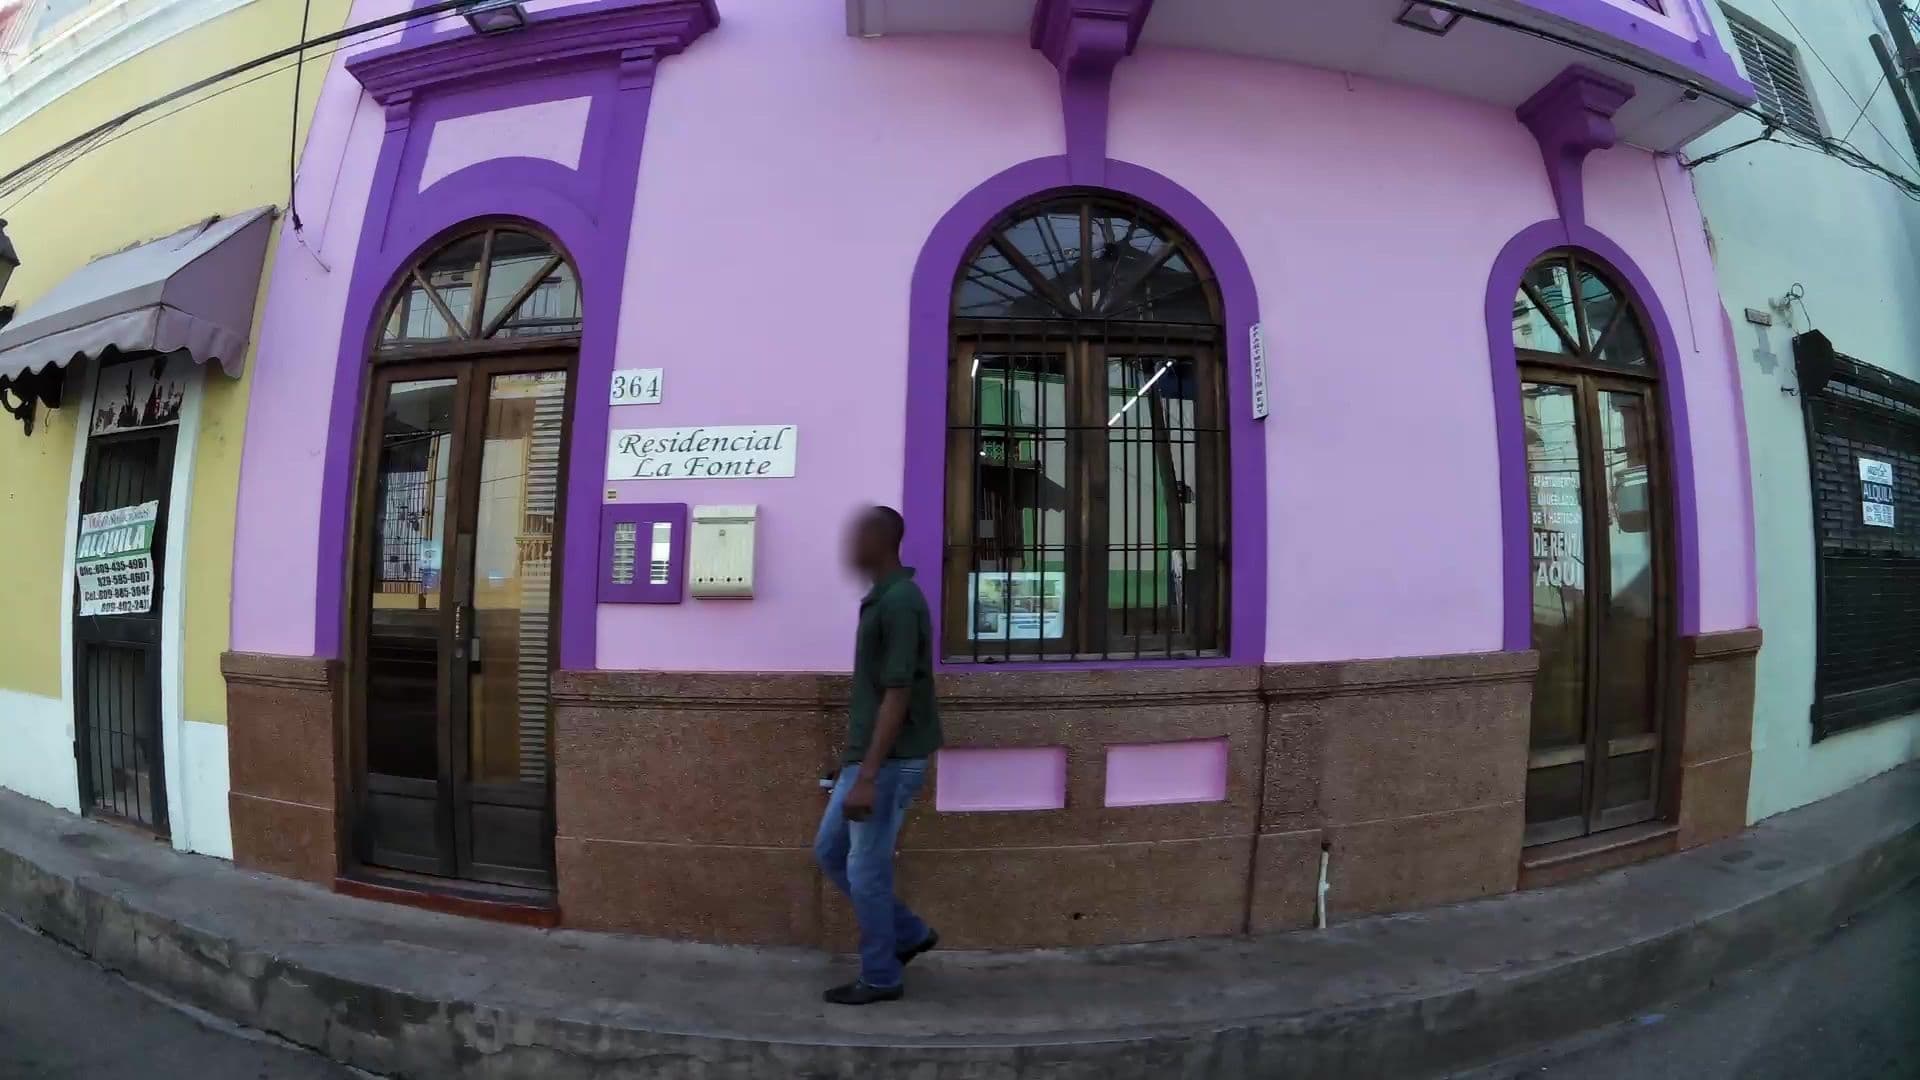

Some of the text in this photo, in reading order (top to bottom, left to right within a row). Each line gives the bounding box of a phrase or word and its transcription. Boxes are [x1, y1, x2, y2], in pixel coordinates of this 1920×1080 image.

[612, 375, 660, 399] 364
[618, 427, 792, 458] Residencial
[631, 456, 772, 478] La Fonte
[79, 525, 146, 558] ALQUILA
[1533, 532, 1548, 557] DE
